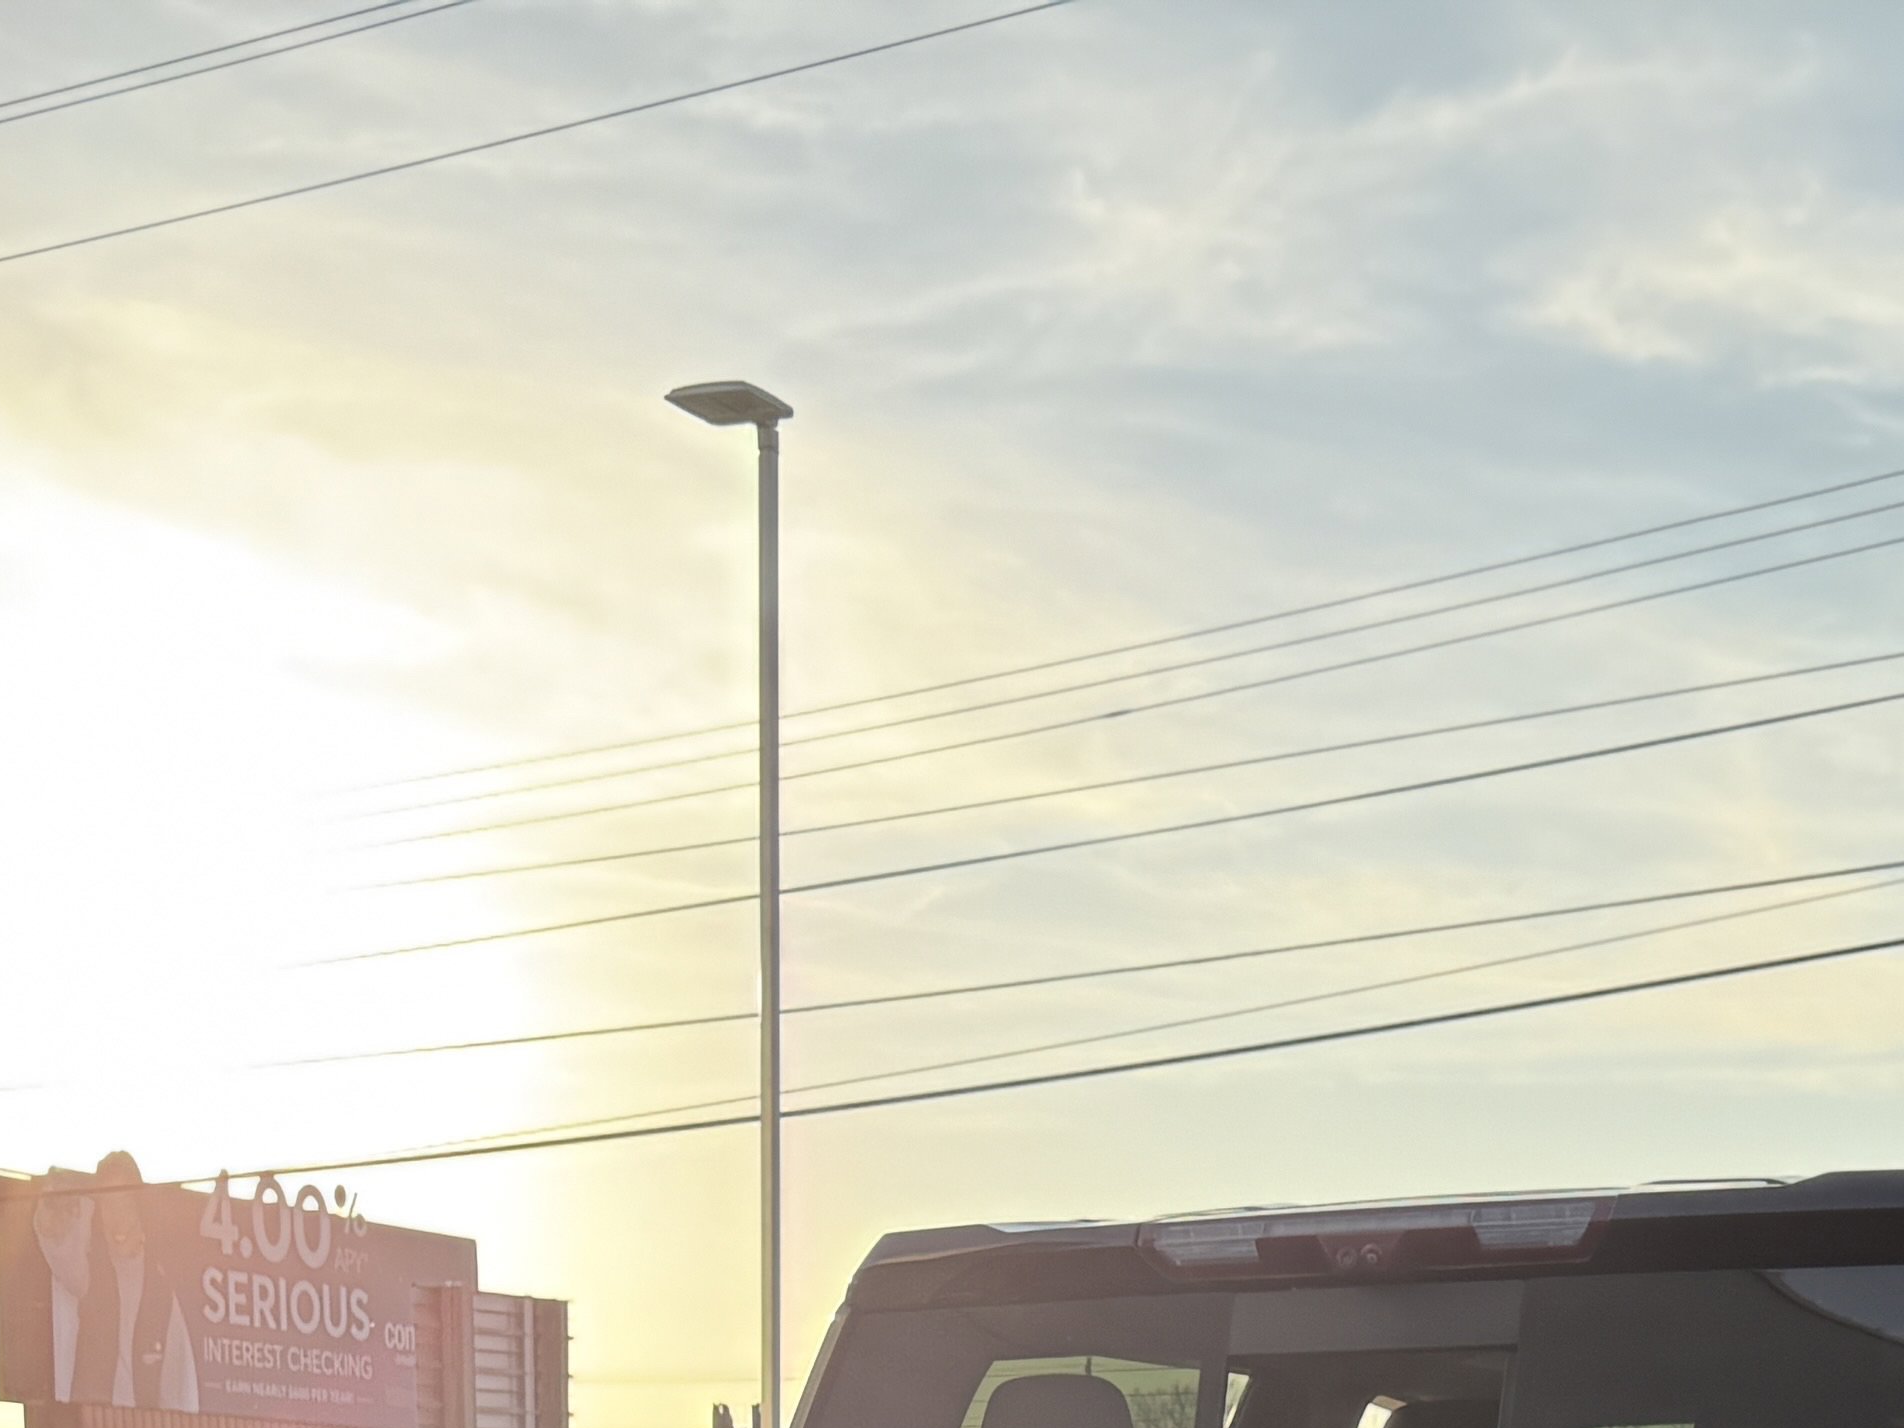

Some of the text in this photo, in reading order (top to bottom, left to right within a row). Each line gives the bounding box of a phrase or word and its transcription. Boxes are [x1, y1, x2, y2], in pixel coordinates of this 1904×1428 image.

[202, 1266, 370, 1342] SERIOUS
[203, 1335, 283, 1370] INTEREST
[287, 1345, 374, 1380] CHECKING
